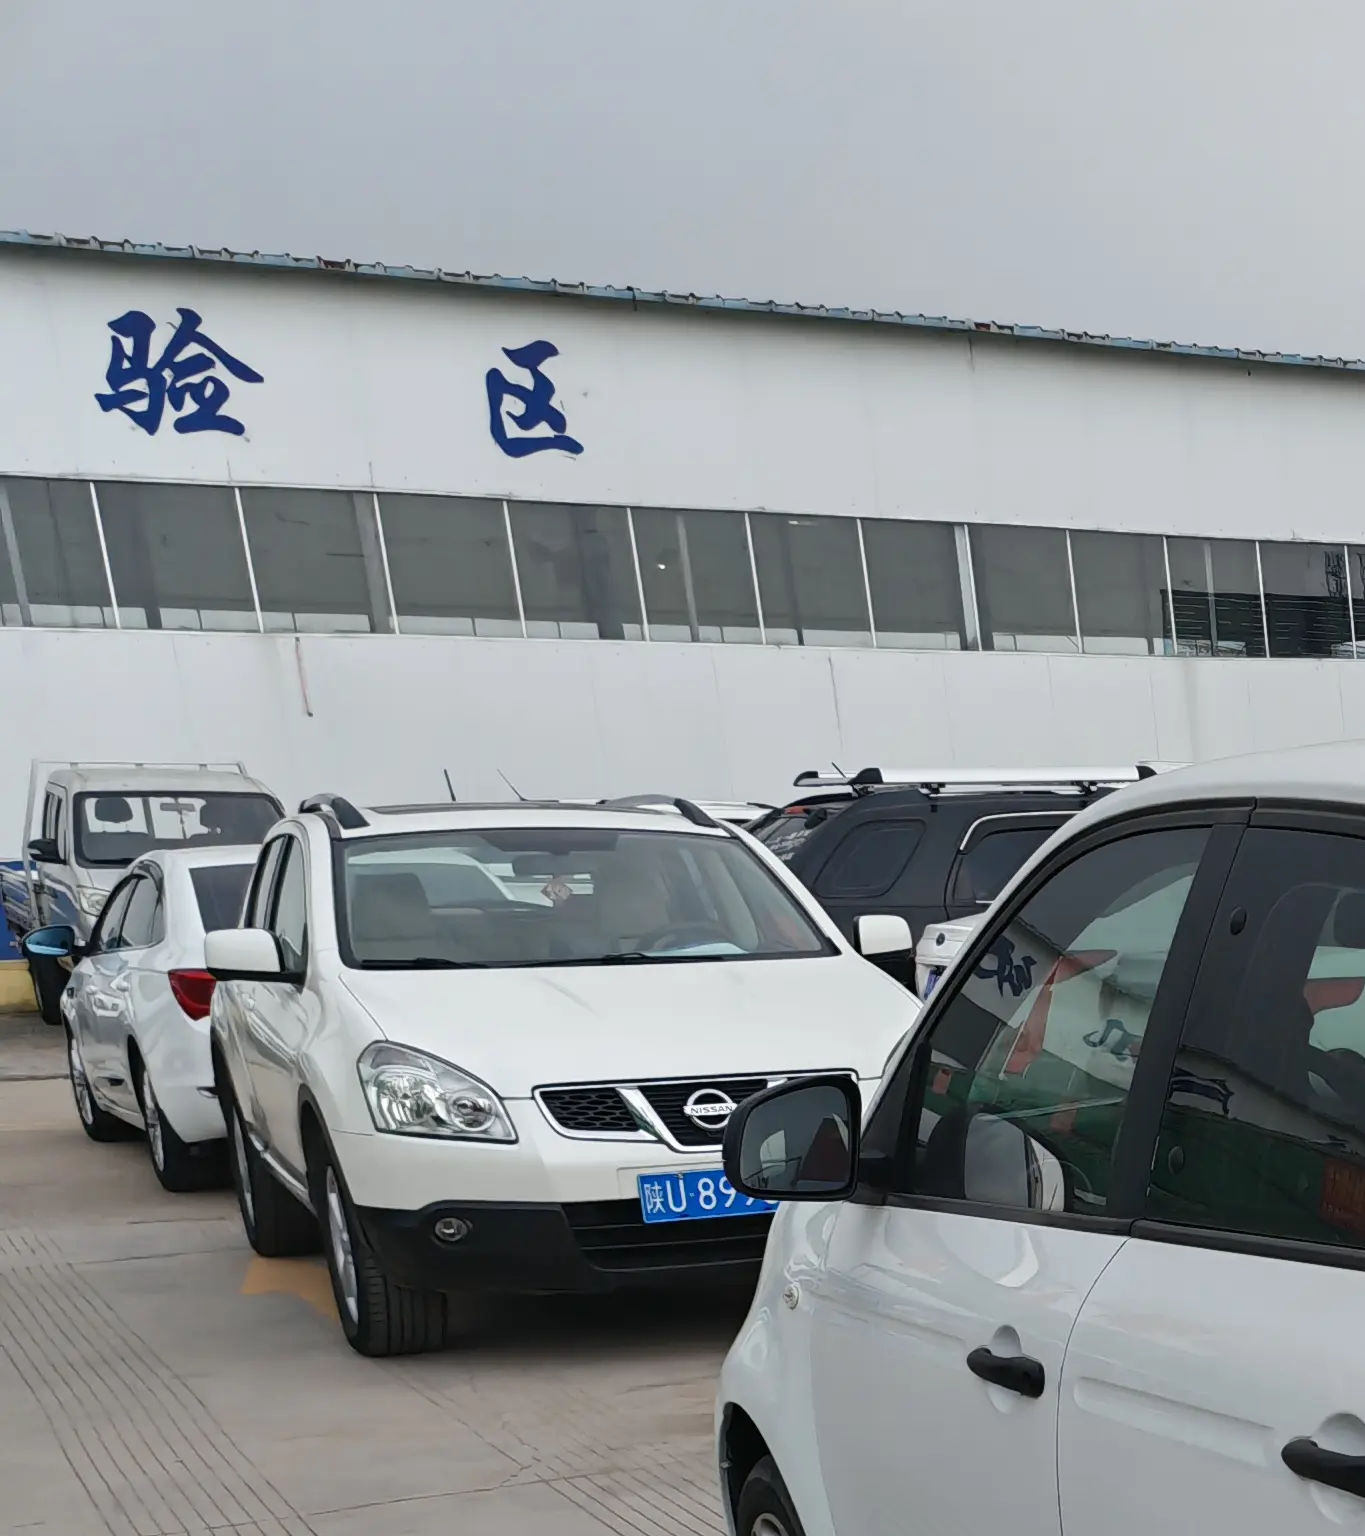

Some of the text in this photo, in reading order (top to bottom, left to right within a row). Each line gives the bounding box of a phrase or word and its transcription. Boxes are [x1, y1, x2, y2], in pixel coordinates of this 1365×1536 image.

[94, 306, 584, 458] 验 区
[690, 1104, 733, 1115] NISSAN
